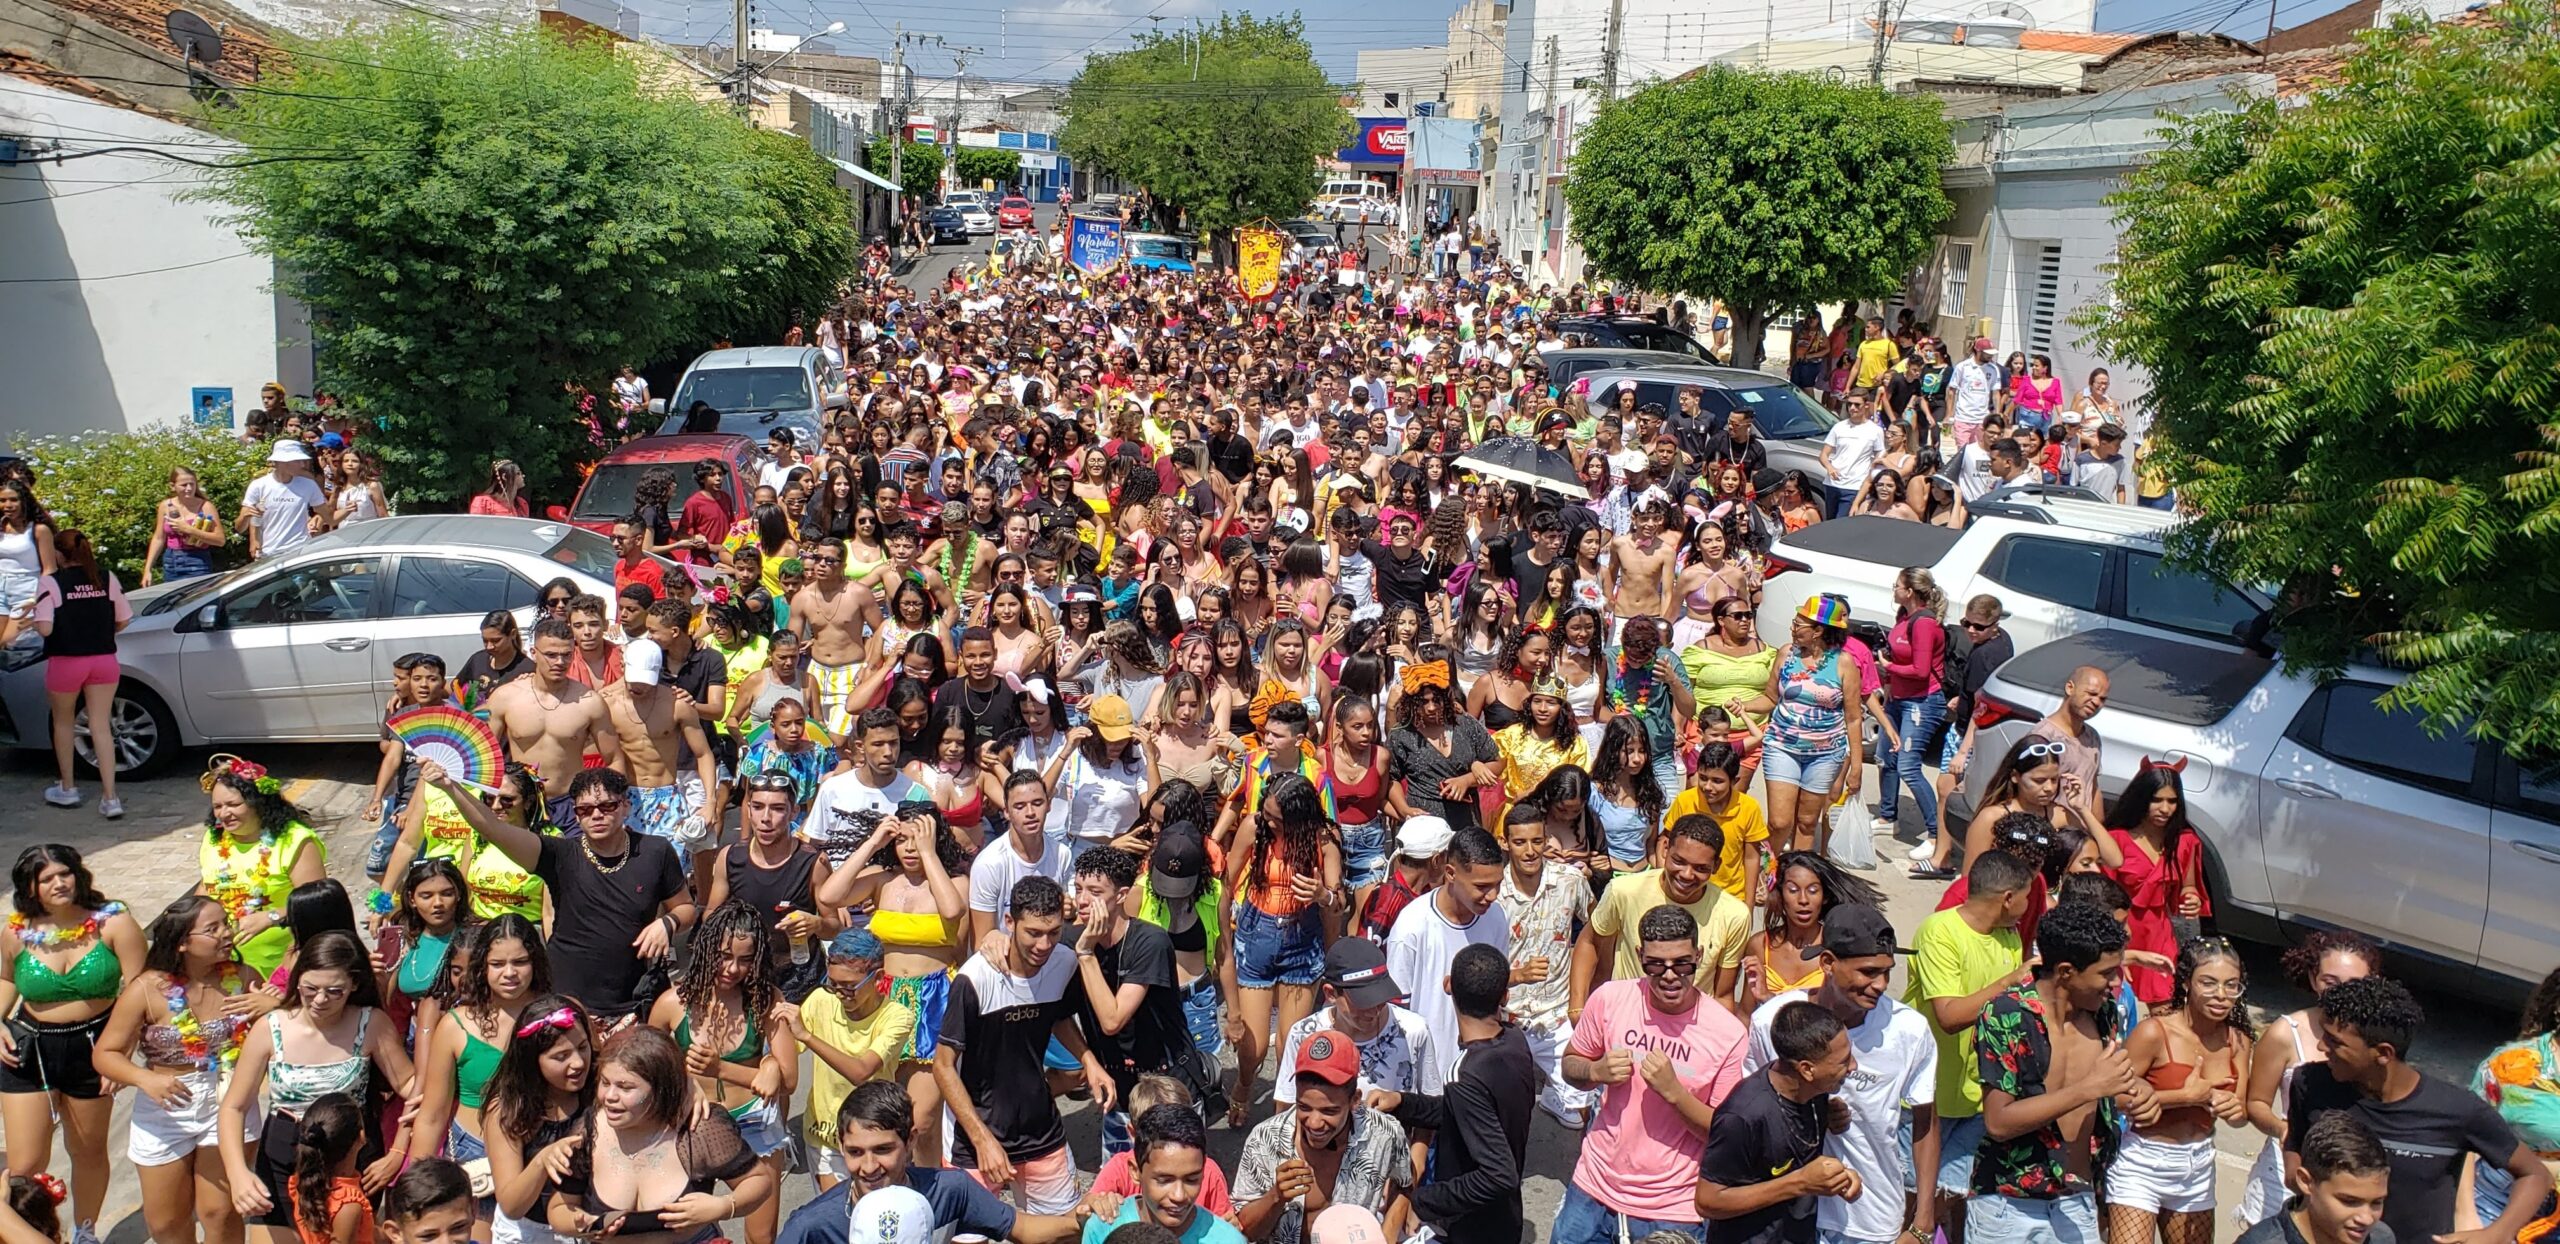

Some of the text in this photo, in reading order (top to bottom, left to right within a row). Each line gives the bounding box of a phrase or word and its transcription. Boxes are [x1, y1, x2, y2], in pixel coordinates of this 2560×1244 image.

[1421, 169, 1480, 179] ROBERTO MOTOS
[74, 584, 95, 592] VISI
[66, 590, 107, 600] RWANDA
[1624, 1029, 1691, 1063] CALVIN
